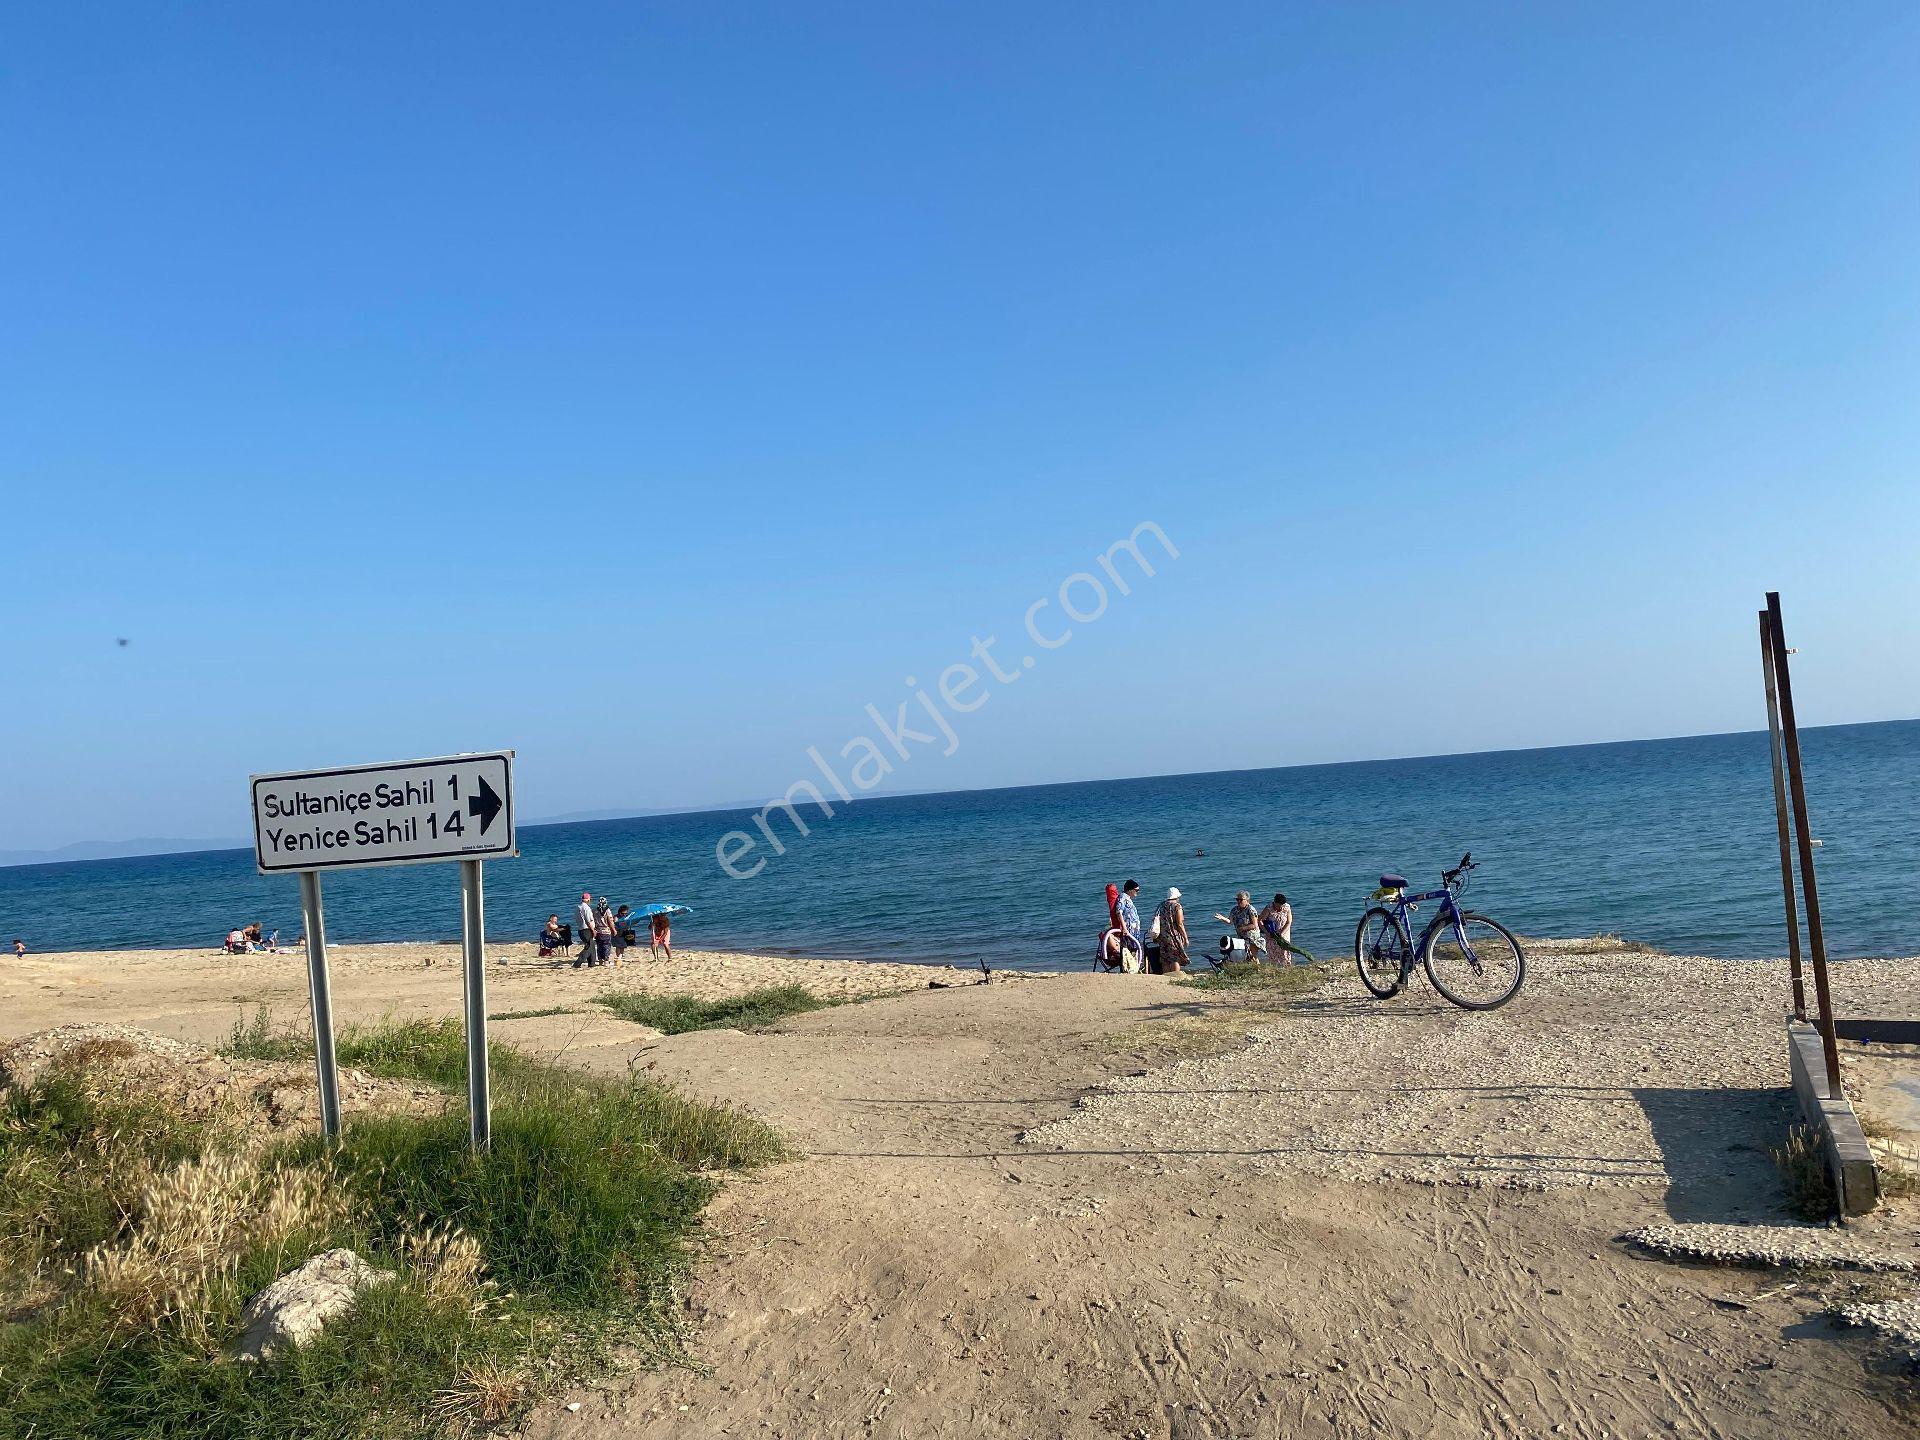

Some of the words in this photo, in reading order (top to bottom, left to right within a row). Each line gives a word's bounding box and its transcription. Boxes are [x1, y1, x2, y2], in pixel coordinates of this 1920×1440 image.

[264, 789, 371, 818] Sultaniçe
[375, 779, 434, 808] Sahil
[447, 774, 459, 801] 1
[266, 827, 350, 852] Yenice
[354, 817, 418, 846] Sahil
[426, 810, 465, 839] 14
